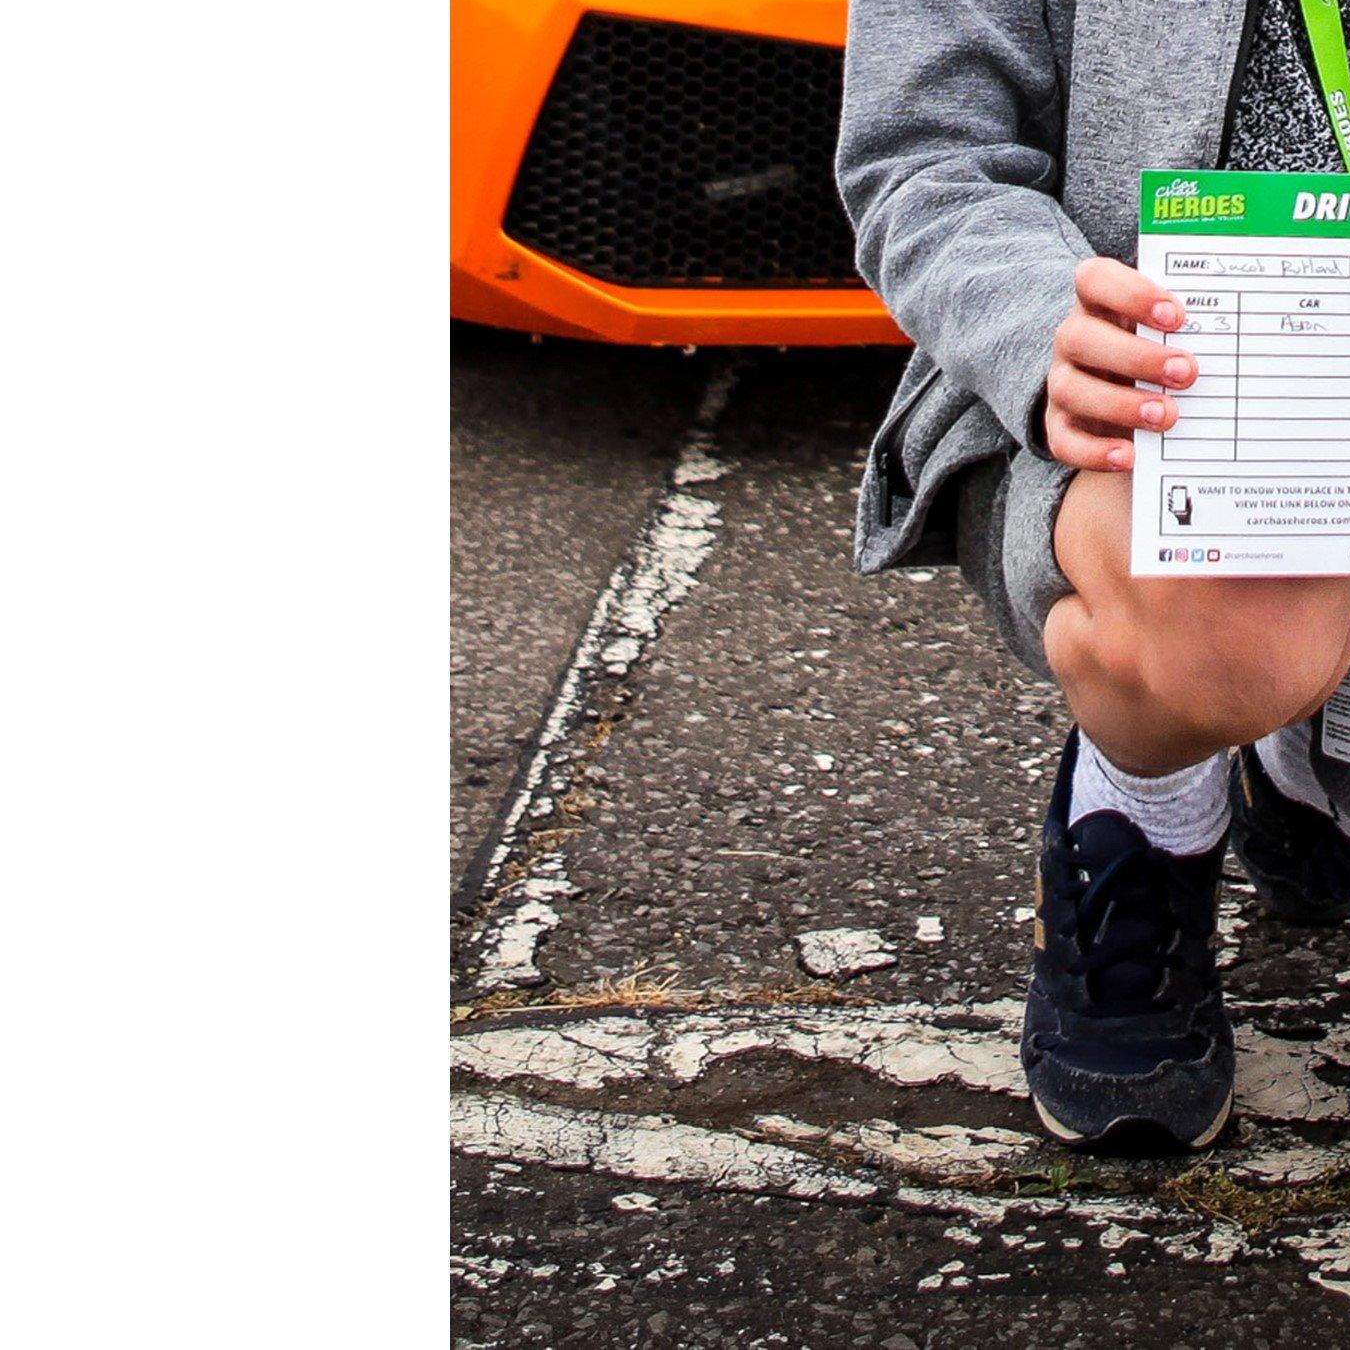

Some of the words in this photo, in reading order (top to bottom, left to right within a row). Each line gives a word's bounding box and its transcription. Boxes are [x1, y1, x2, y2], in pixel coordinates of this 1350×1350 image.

[1154, 194, 1246, 219] HEROES
[1173, 259, 1209, 270] NAME:
[1186, 296, 1219, 307] MILES
[1299, 298, 1320, 308] CAR
[1198, 486, 1226, 495] WANT
[1230, 486, 1241, 495] TO
[1244, 486, 1274, 495] KNOW
[1276, 486, 1302, 495] YOUR
[1304, 486, 1331, 495] PLACE
[1334, 486, 1344, 494] IN
[1234, 500, 1258, 508] VIEW
[1260, 500, 1277, 508] THE
[1280, 500, 1301, 508] LINK
[1304, 500, 1336, 508] BELOW
